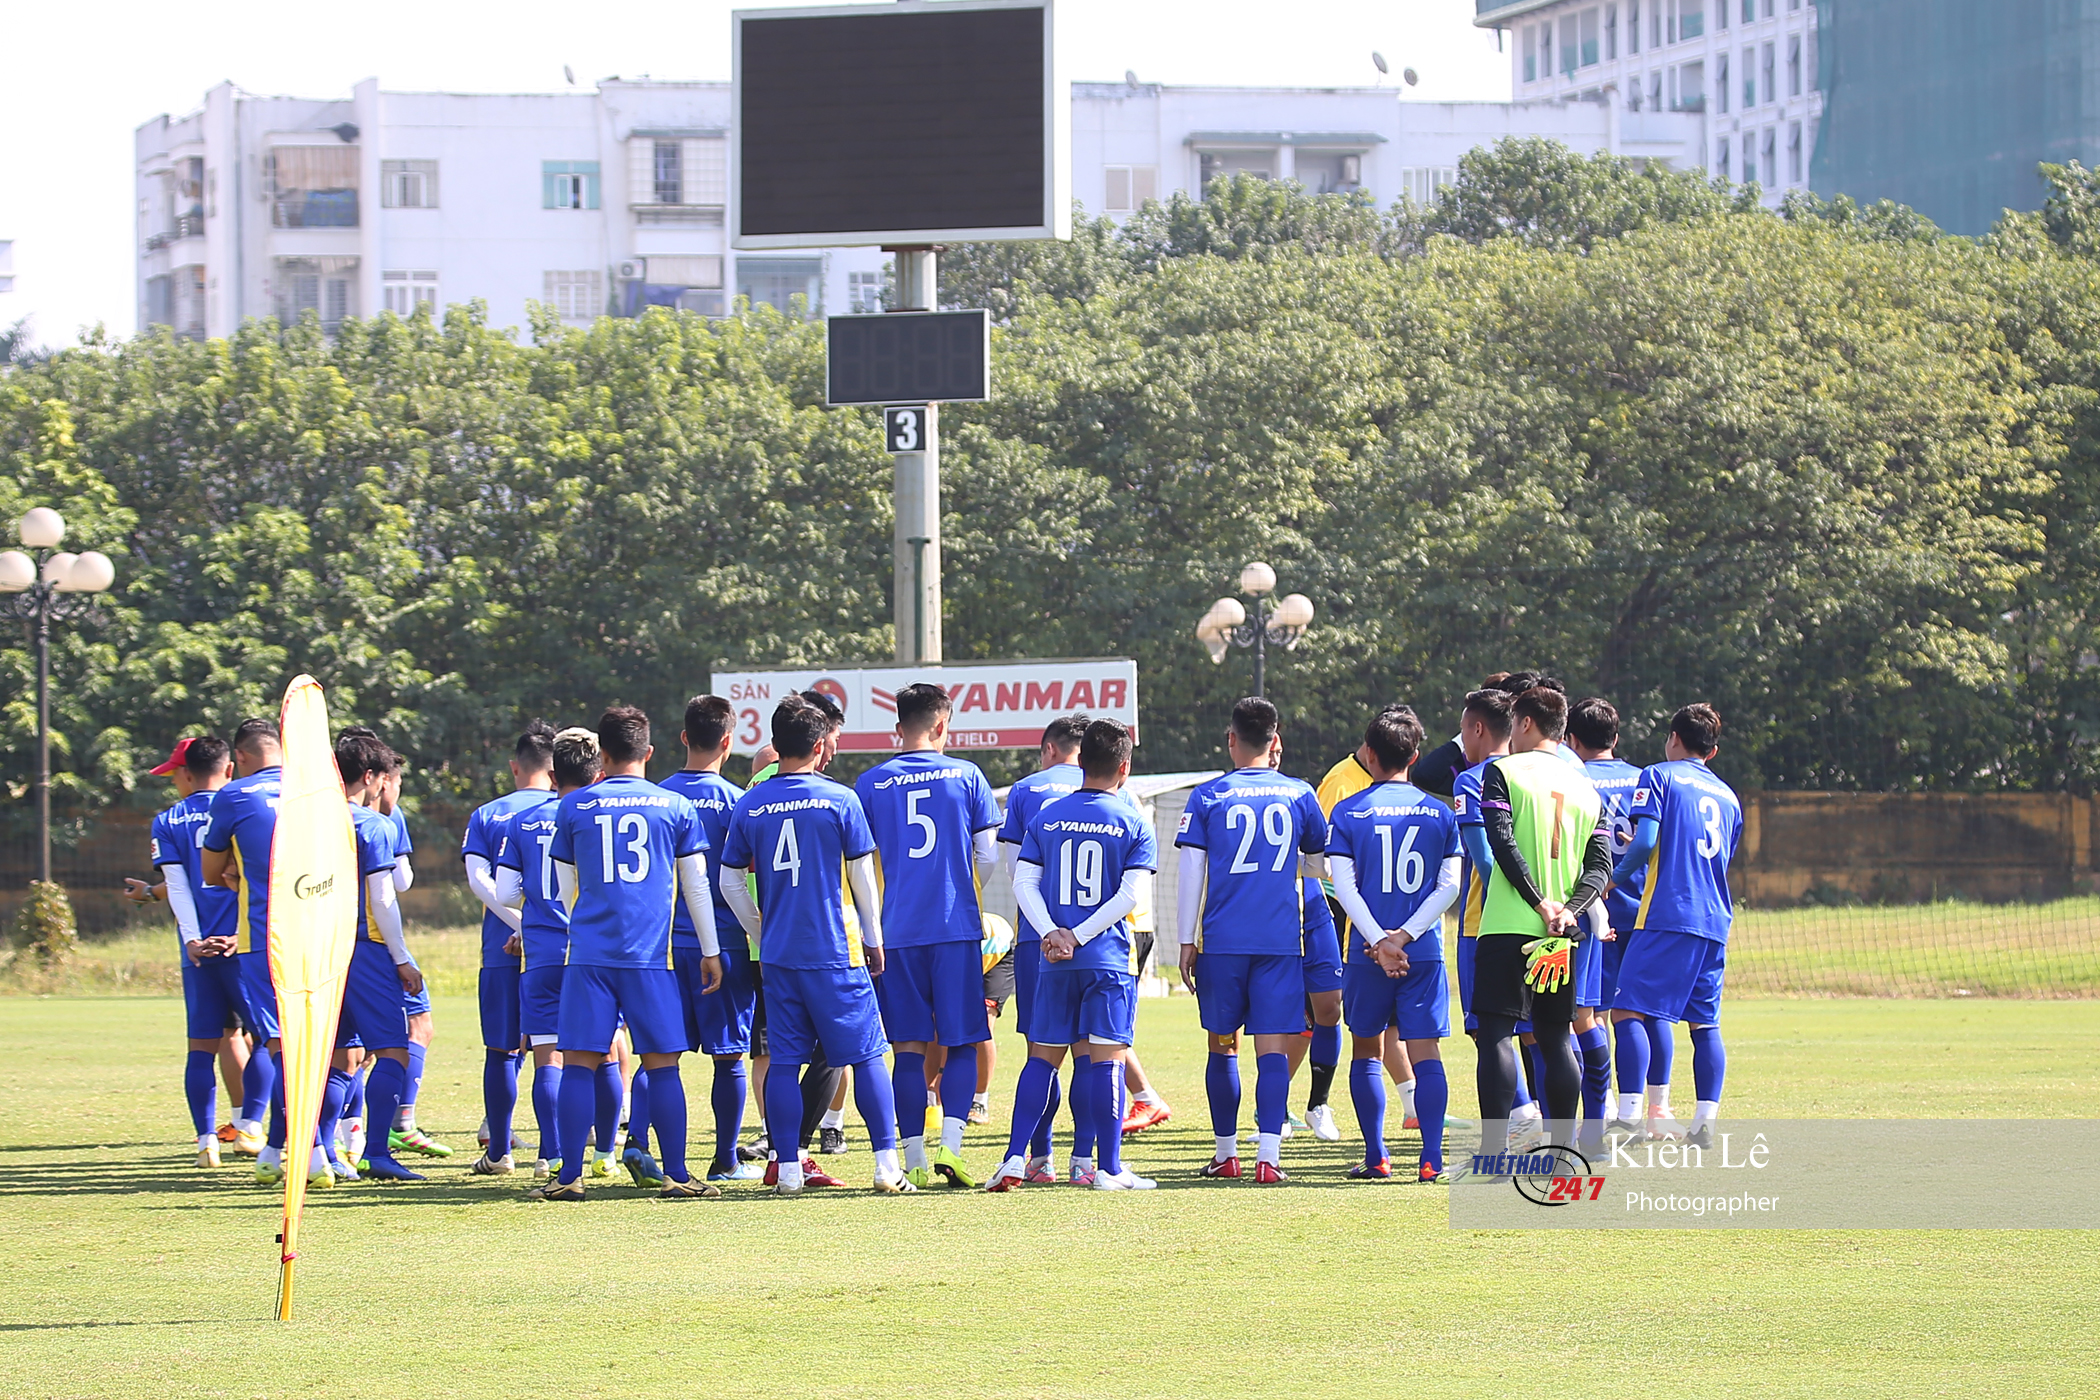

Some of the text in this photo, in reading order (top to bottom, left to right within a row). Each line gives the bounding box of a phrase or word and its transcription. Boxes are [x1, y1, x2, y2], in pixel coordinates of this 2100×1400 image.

[895, 410, 918, 450] 3
[730, 680, 770, 700] SÂN
[740, 709, 762, 745] 3
[956, 732, 999, 746] FIELD
[892, 768, 963, 786] YANMAR
[1234, 786, 1299, 798] YANMAR
[597, 796, 670, 808] YANMAR
[765, 798, 831, 815] YANMAR
[1373, 806, 1440, 819] YANMAR
[907, 788, 937, 859] 5
[1060, 821, 1125, 838] YANMAR
[1226, 803, 1293, 875] 29
[1551, 791, 1565, 860] 1
[1697, 796, 1721, 860] 3
[594, 813, 650, 883] 13
[773, 818, 801, 887] 4
[1375, 825, 1425, 894] 16
[1060, 838, 1103, 907] 19
